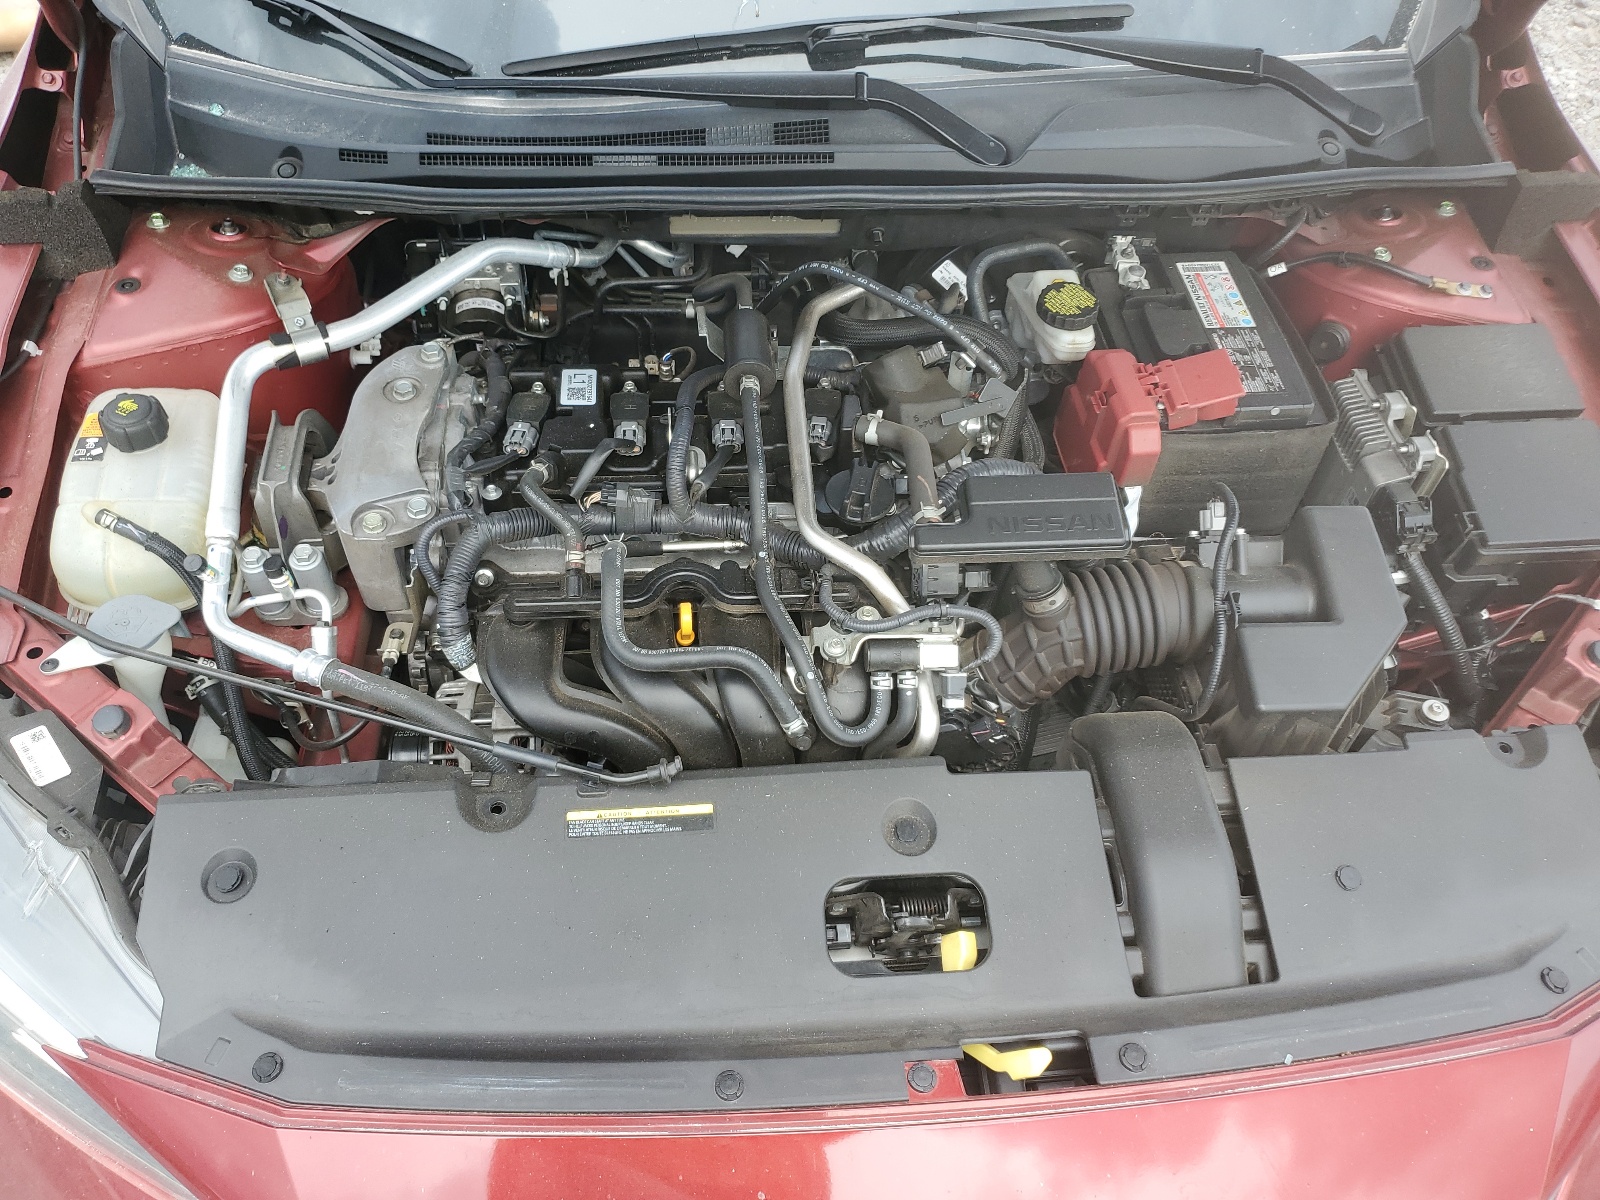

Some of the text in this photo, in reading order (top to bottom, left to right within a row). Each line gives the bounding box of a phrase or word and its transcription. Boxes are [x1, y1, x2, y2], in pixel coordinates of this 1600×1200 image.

[1185, 274, 1203, 301] NISSAN
[1197, 302, 1215, 328] RENAULT
[572, 373, 587, 384] L1
[988, 512, 1116, 535] NISSAN
